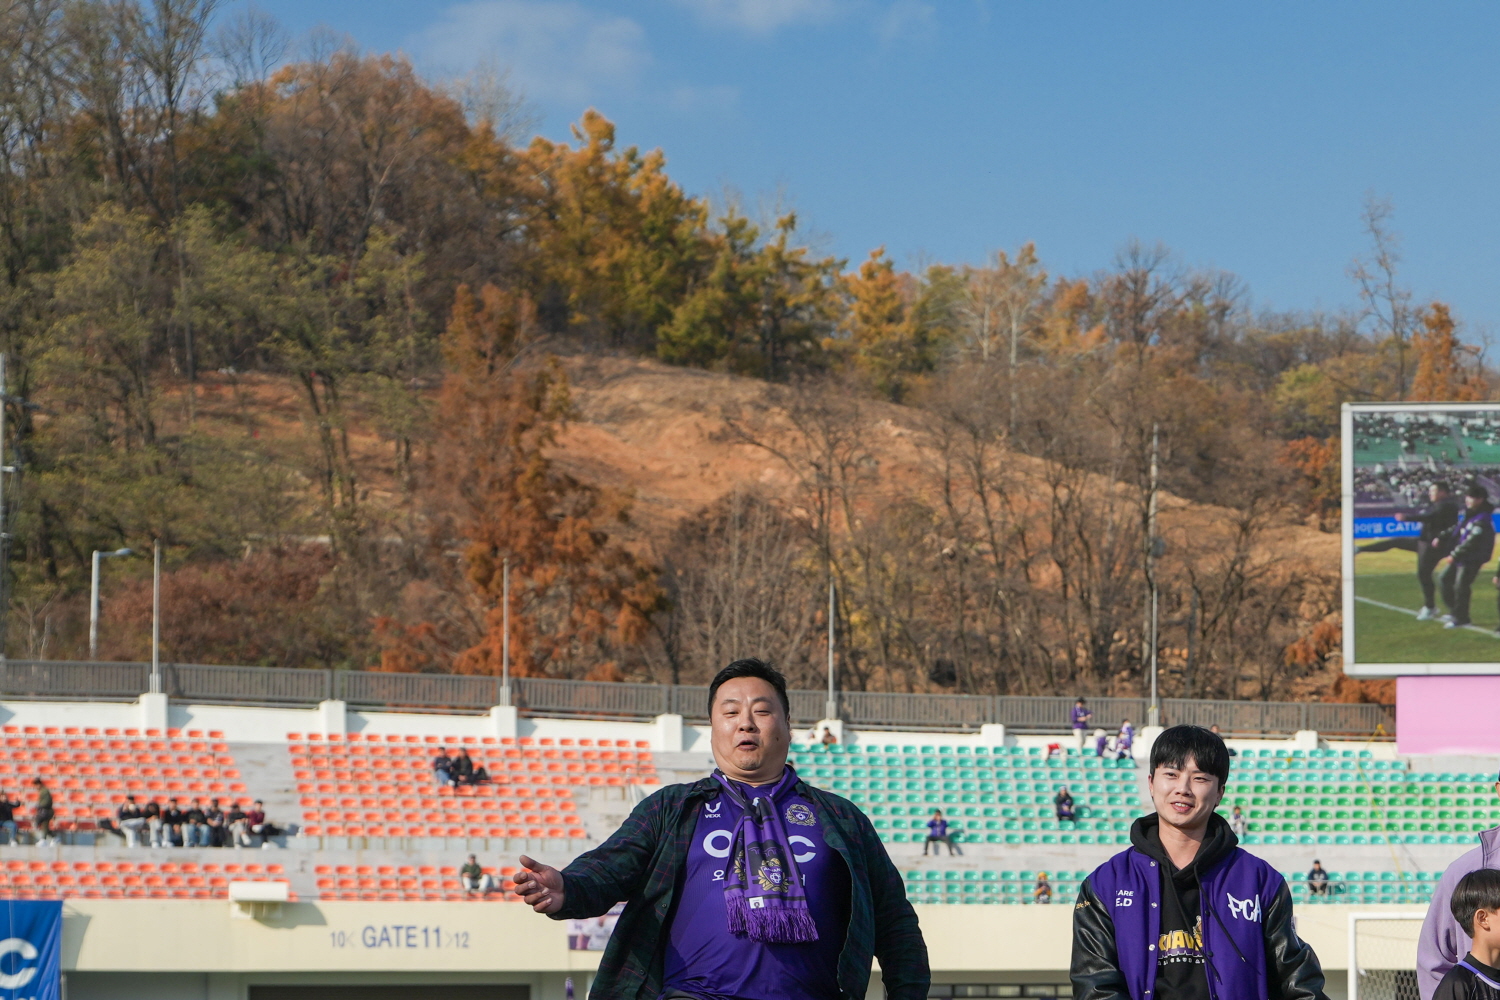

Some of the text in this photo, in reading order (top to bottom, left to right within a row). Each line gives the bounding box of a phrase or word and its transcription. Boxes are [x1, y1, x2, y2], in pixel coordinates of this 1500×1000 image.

[703, 829, 816, 863] OC
[330, 931, 346, 948] 10
[454, 931, 469, 948] 12
